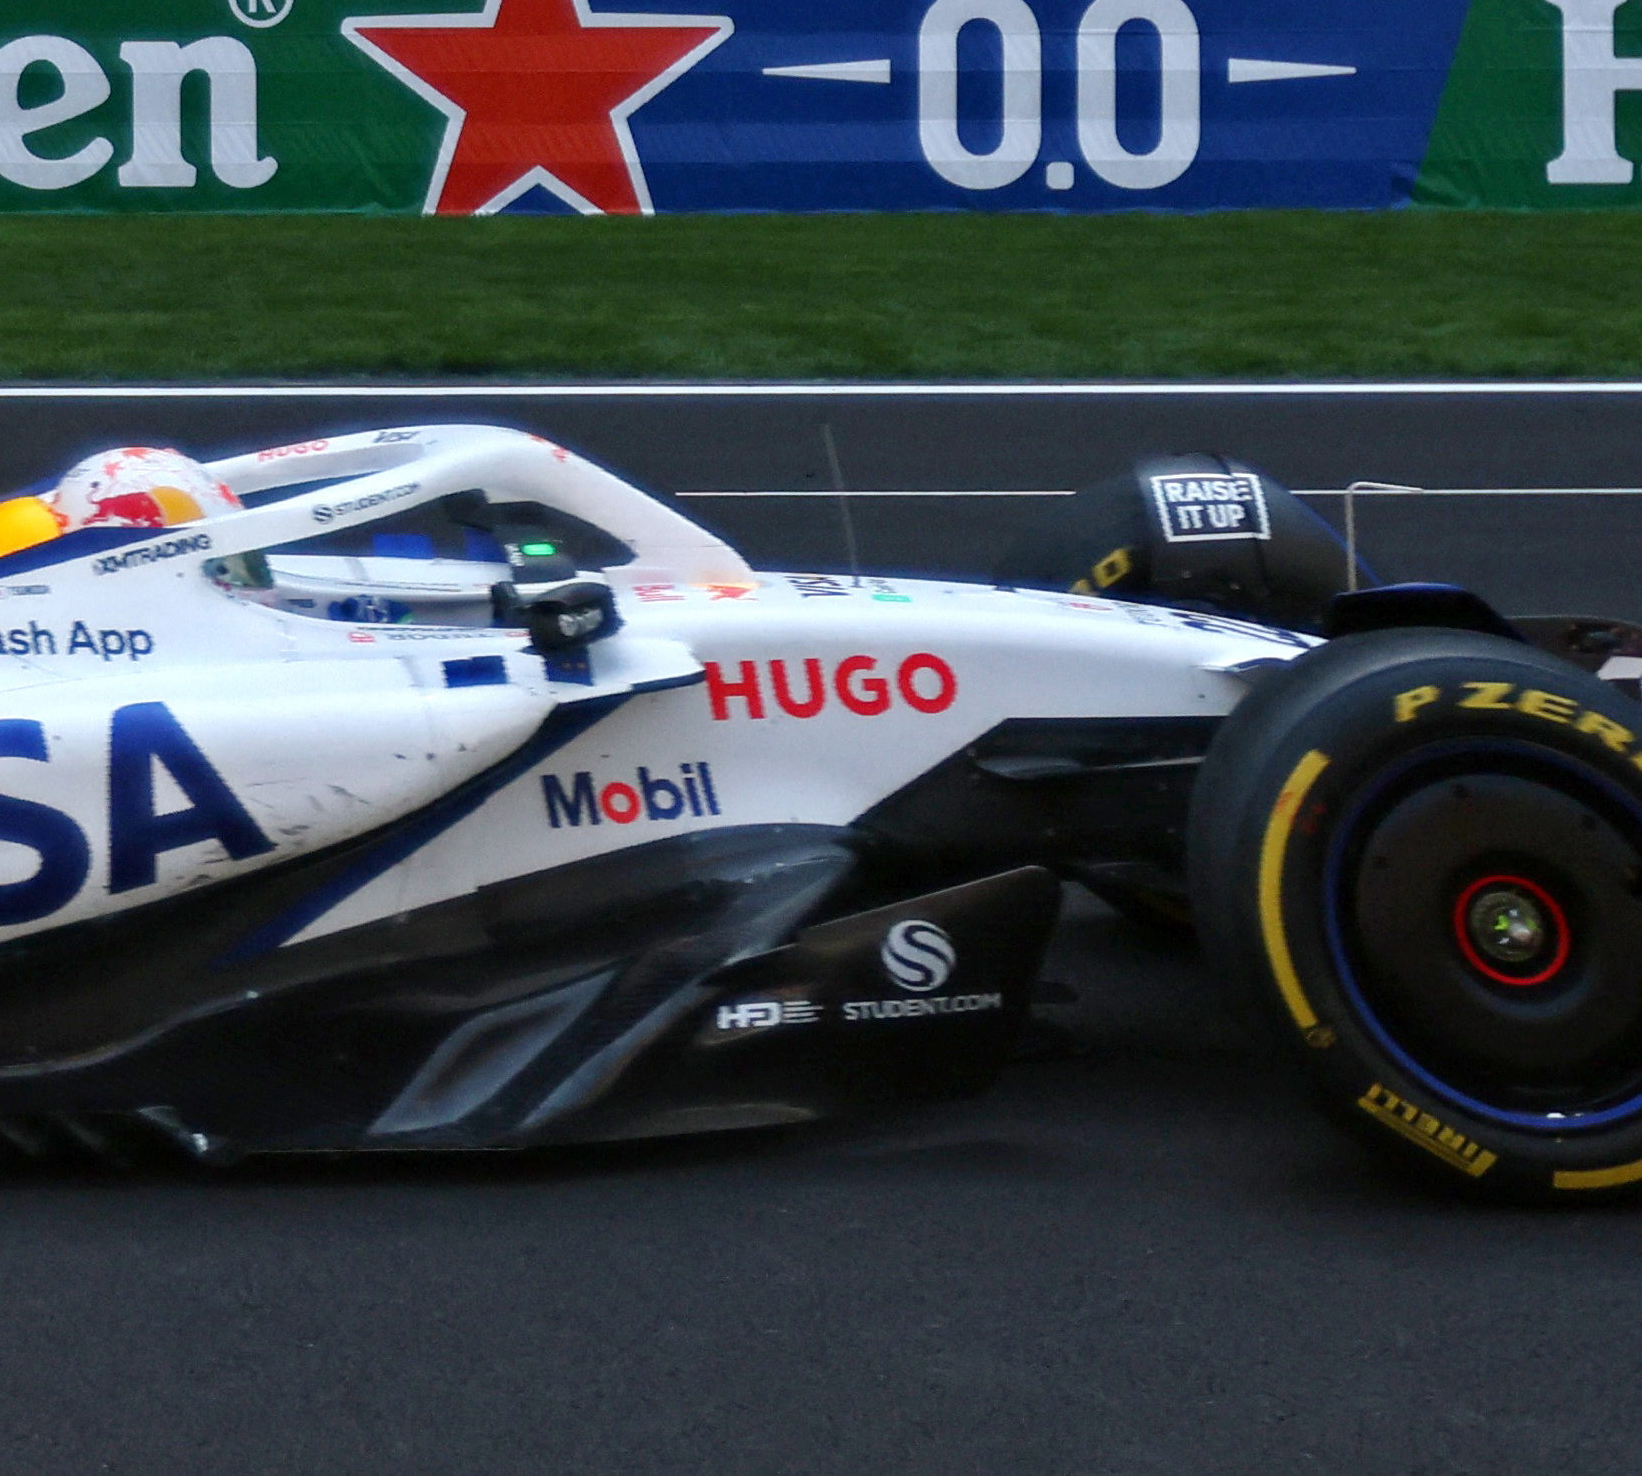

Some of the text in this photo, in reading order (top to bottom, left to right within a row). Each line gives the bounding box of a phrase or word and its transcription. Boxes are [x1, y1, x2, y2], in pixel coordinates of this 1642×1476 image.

[1165, 481, 1253, 505] RAISE
[1175, 504, 1246, 530] IT UP
[68, 621, 154, 662] App
[707, 652, 958, 722] HUGO
[1394, 684, 1441, 723] P
[542, 761, 722, 830] Mobil
[842, 992, 1003, 1023] STUDENT.COM
